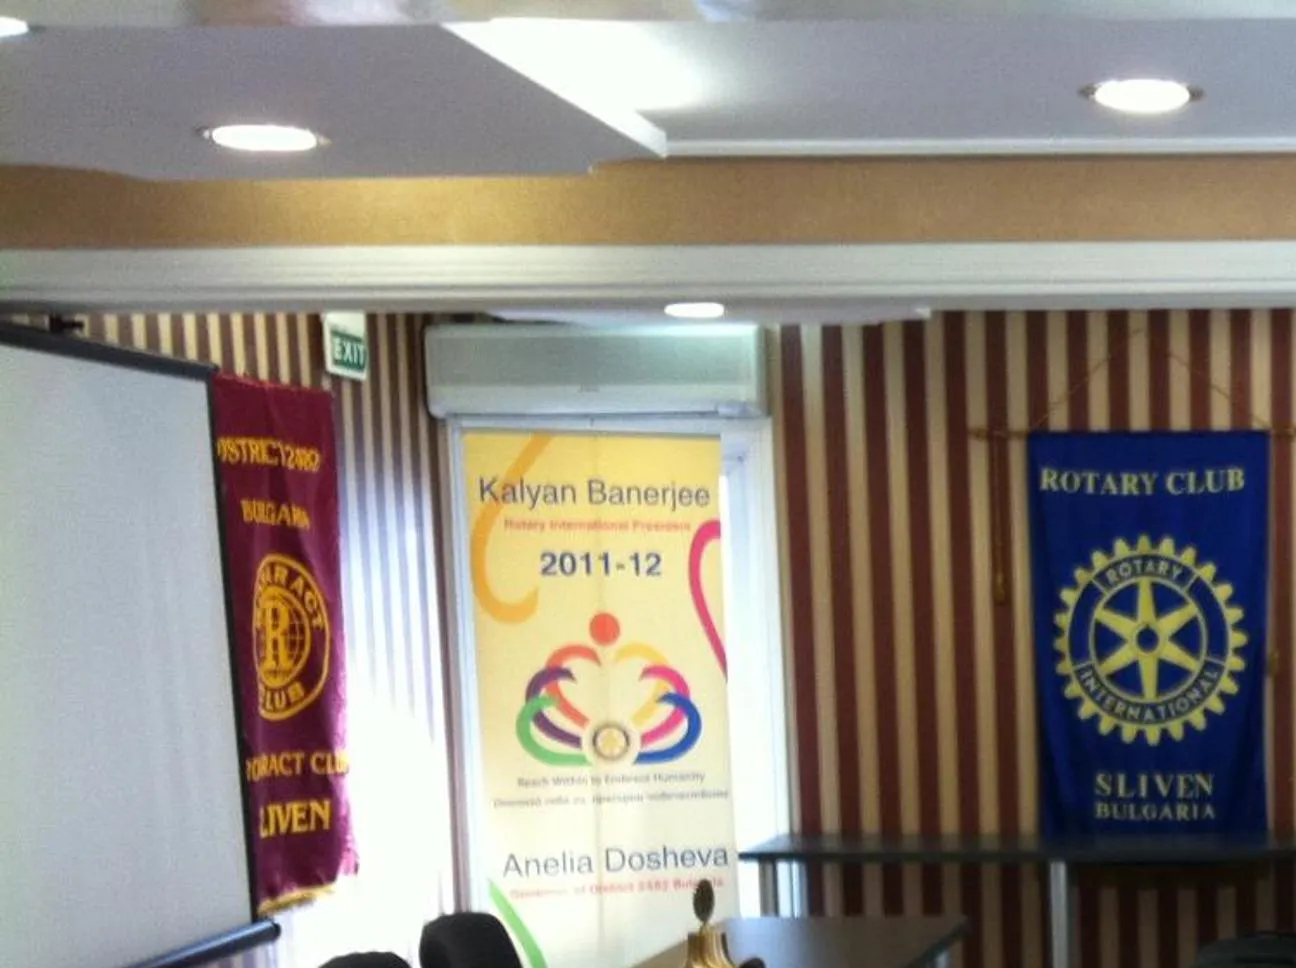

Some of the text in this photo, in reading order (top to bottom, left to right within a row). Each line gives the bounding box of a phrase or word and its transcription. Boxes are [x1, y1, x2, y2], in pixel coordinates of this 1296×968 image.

[331, 337, 364, 365] EXIT
[478, 477, 711, 511] Kalyan Banerjee
[1040, 466, 1245, 495] ROTARY CLUB
[540, 552, 662, 577] 2011-12
[1105, 559, 1183, 585] ROTARY
[1080, 668, 1218, 720] INTERNATIONAL
[1095, 773, 1213, 799] SLIVEN
[1095, 803, 1216, 820] BULGARIA
[503, 845, 729, 877] Anelia Dosheva
